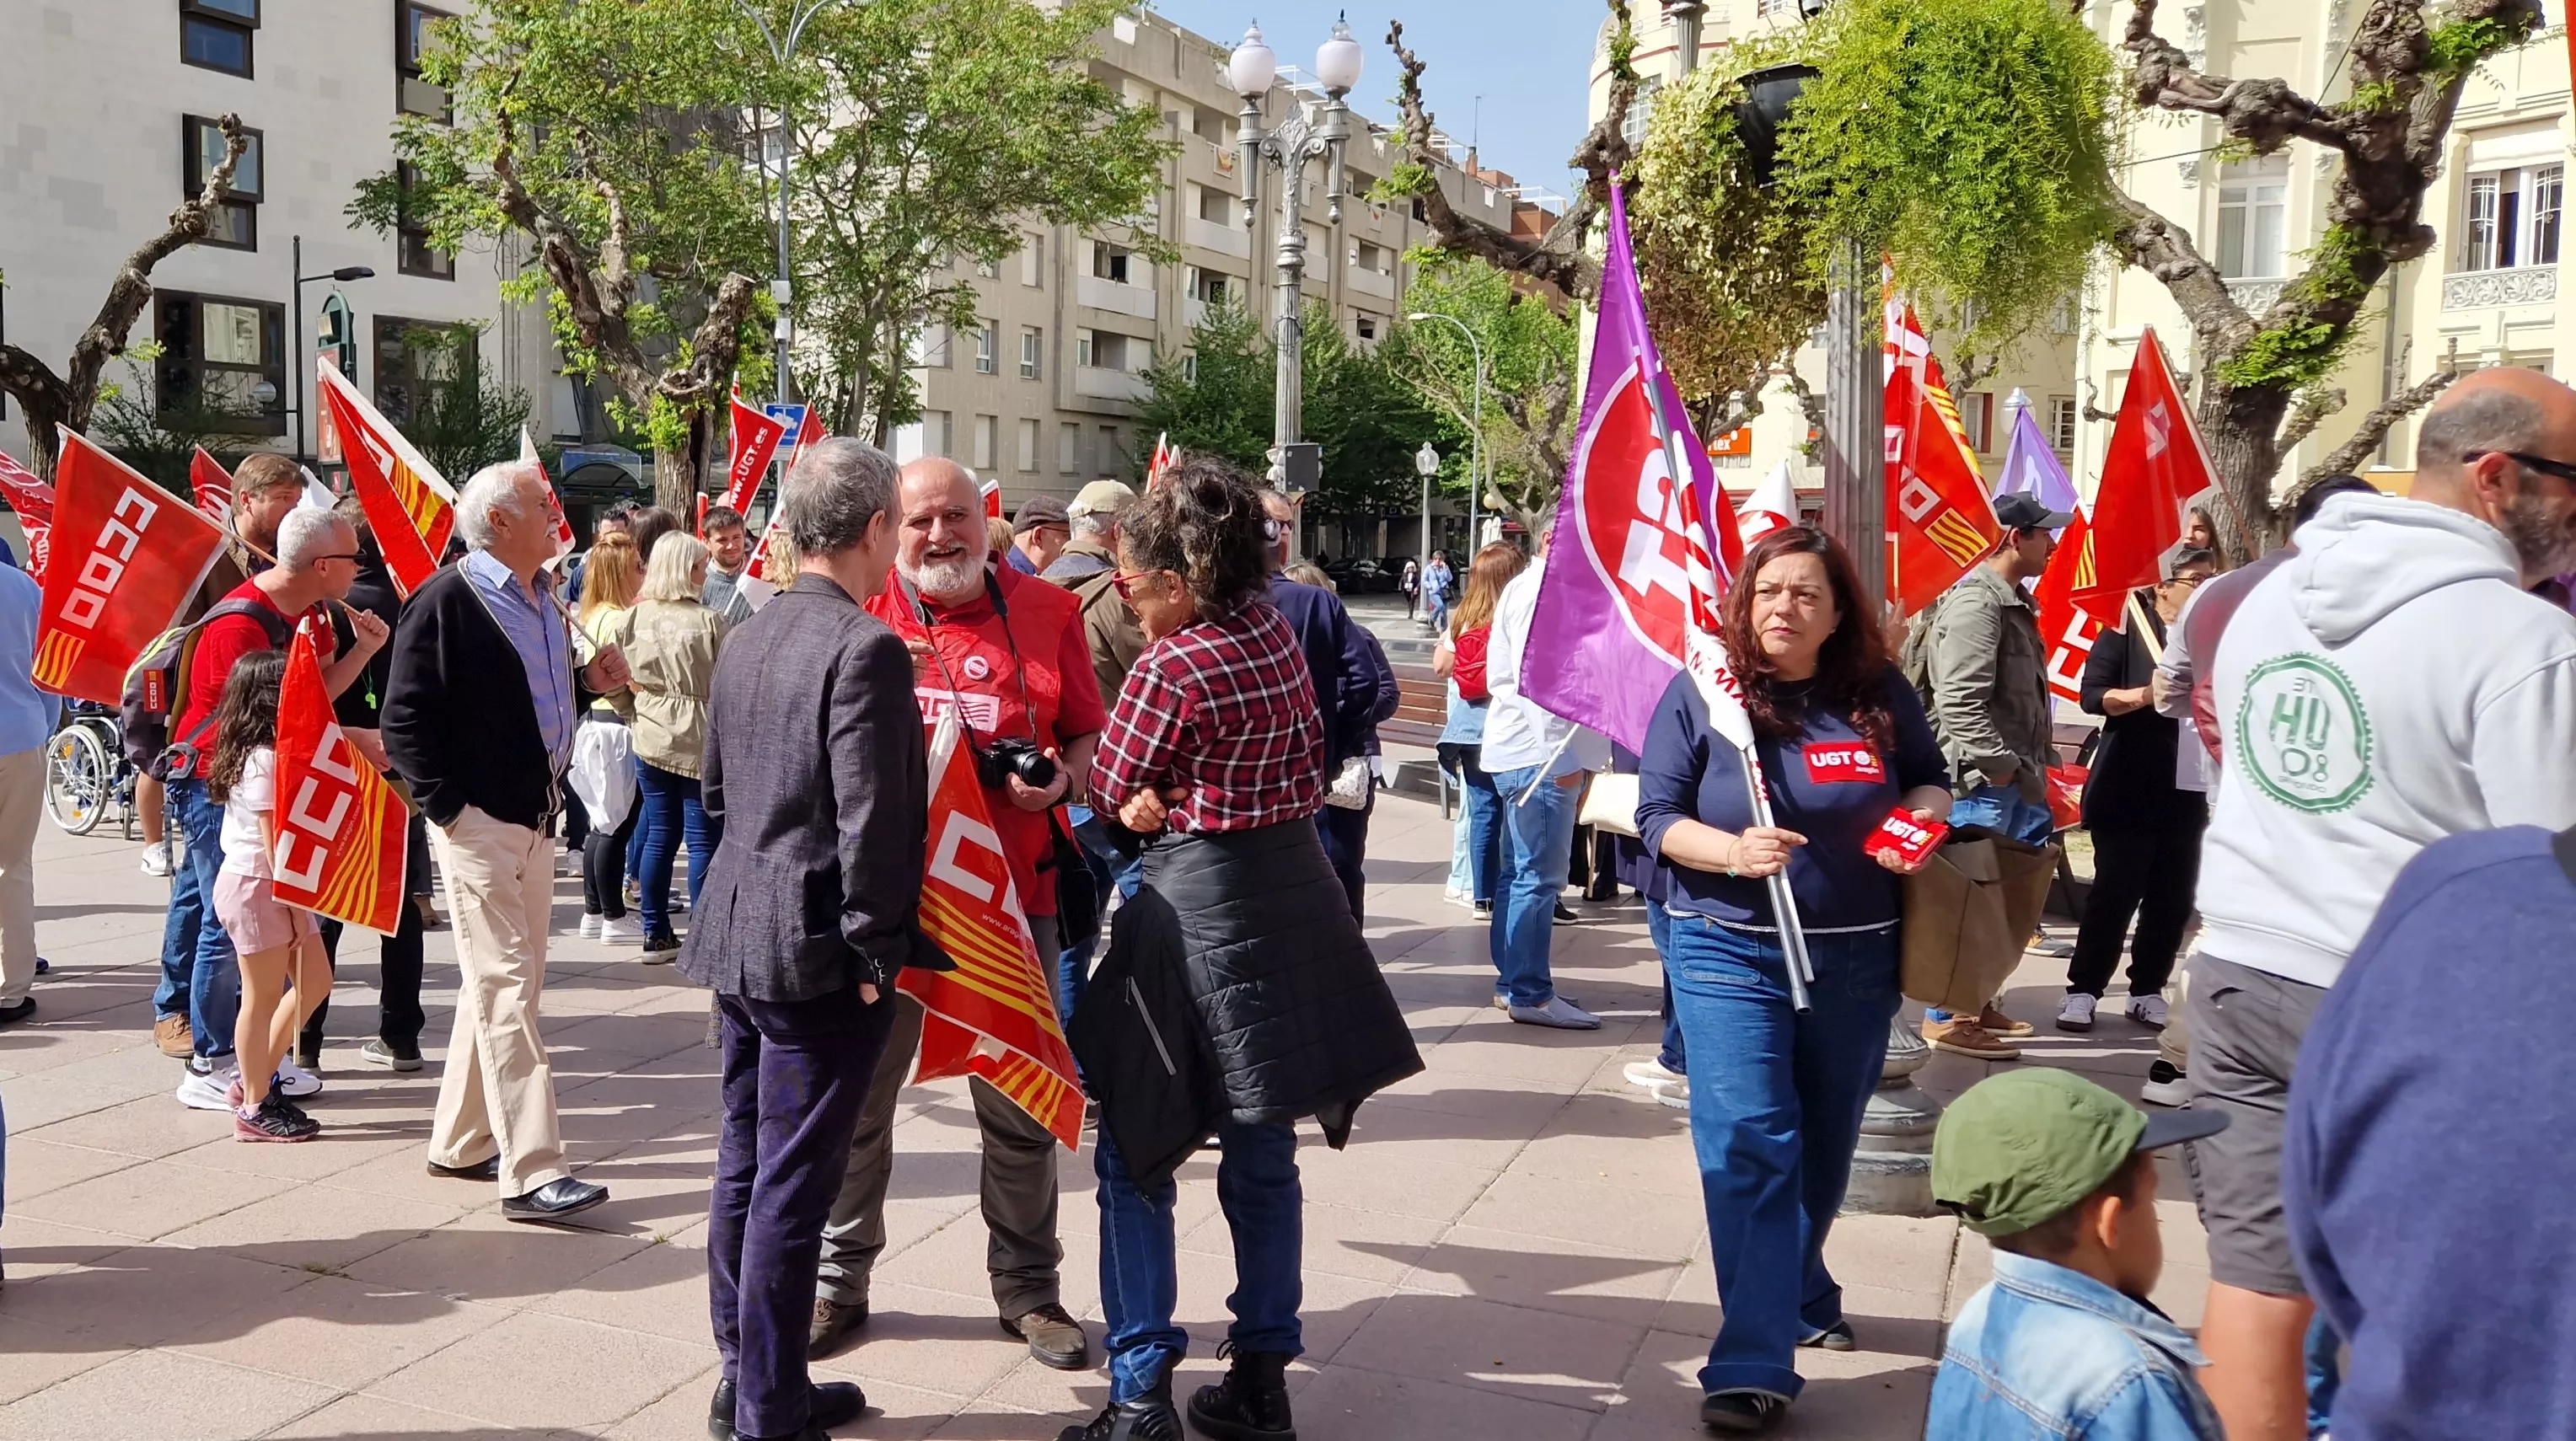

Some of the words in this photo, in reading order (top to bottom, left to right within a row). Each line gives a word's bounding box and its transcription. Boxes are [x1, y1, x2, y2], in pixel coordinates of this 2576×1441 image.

[730, 426, 769, 510] ww.UGT.es
[59, 485, 158, 629] CCOO
[149, 682, 158, 710] CCOO
[1810, 751, 1852, 768] UGT
[1882, 817, 1919, 839] UGT
